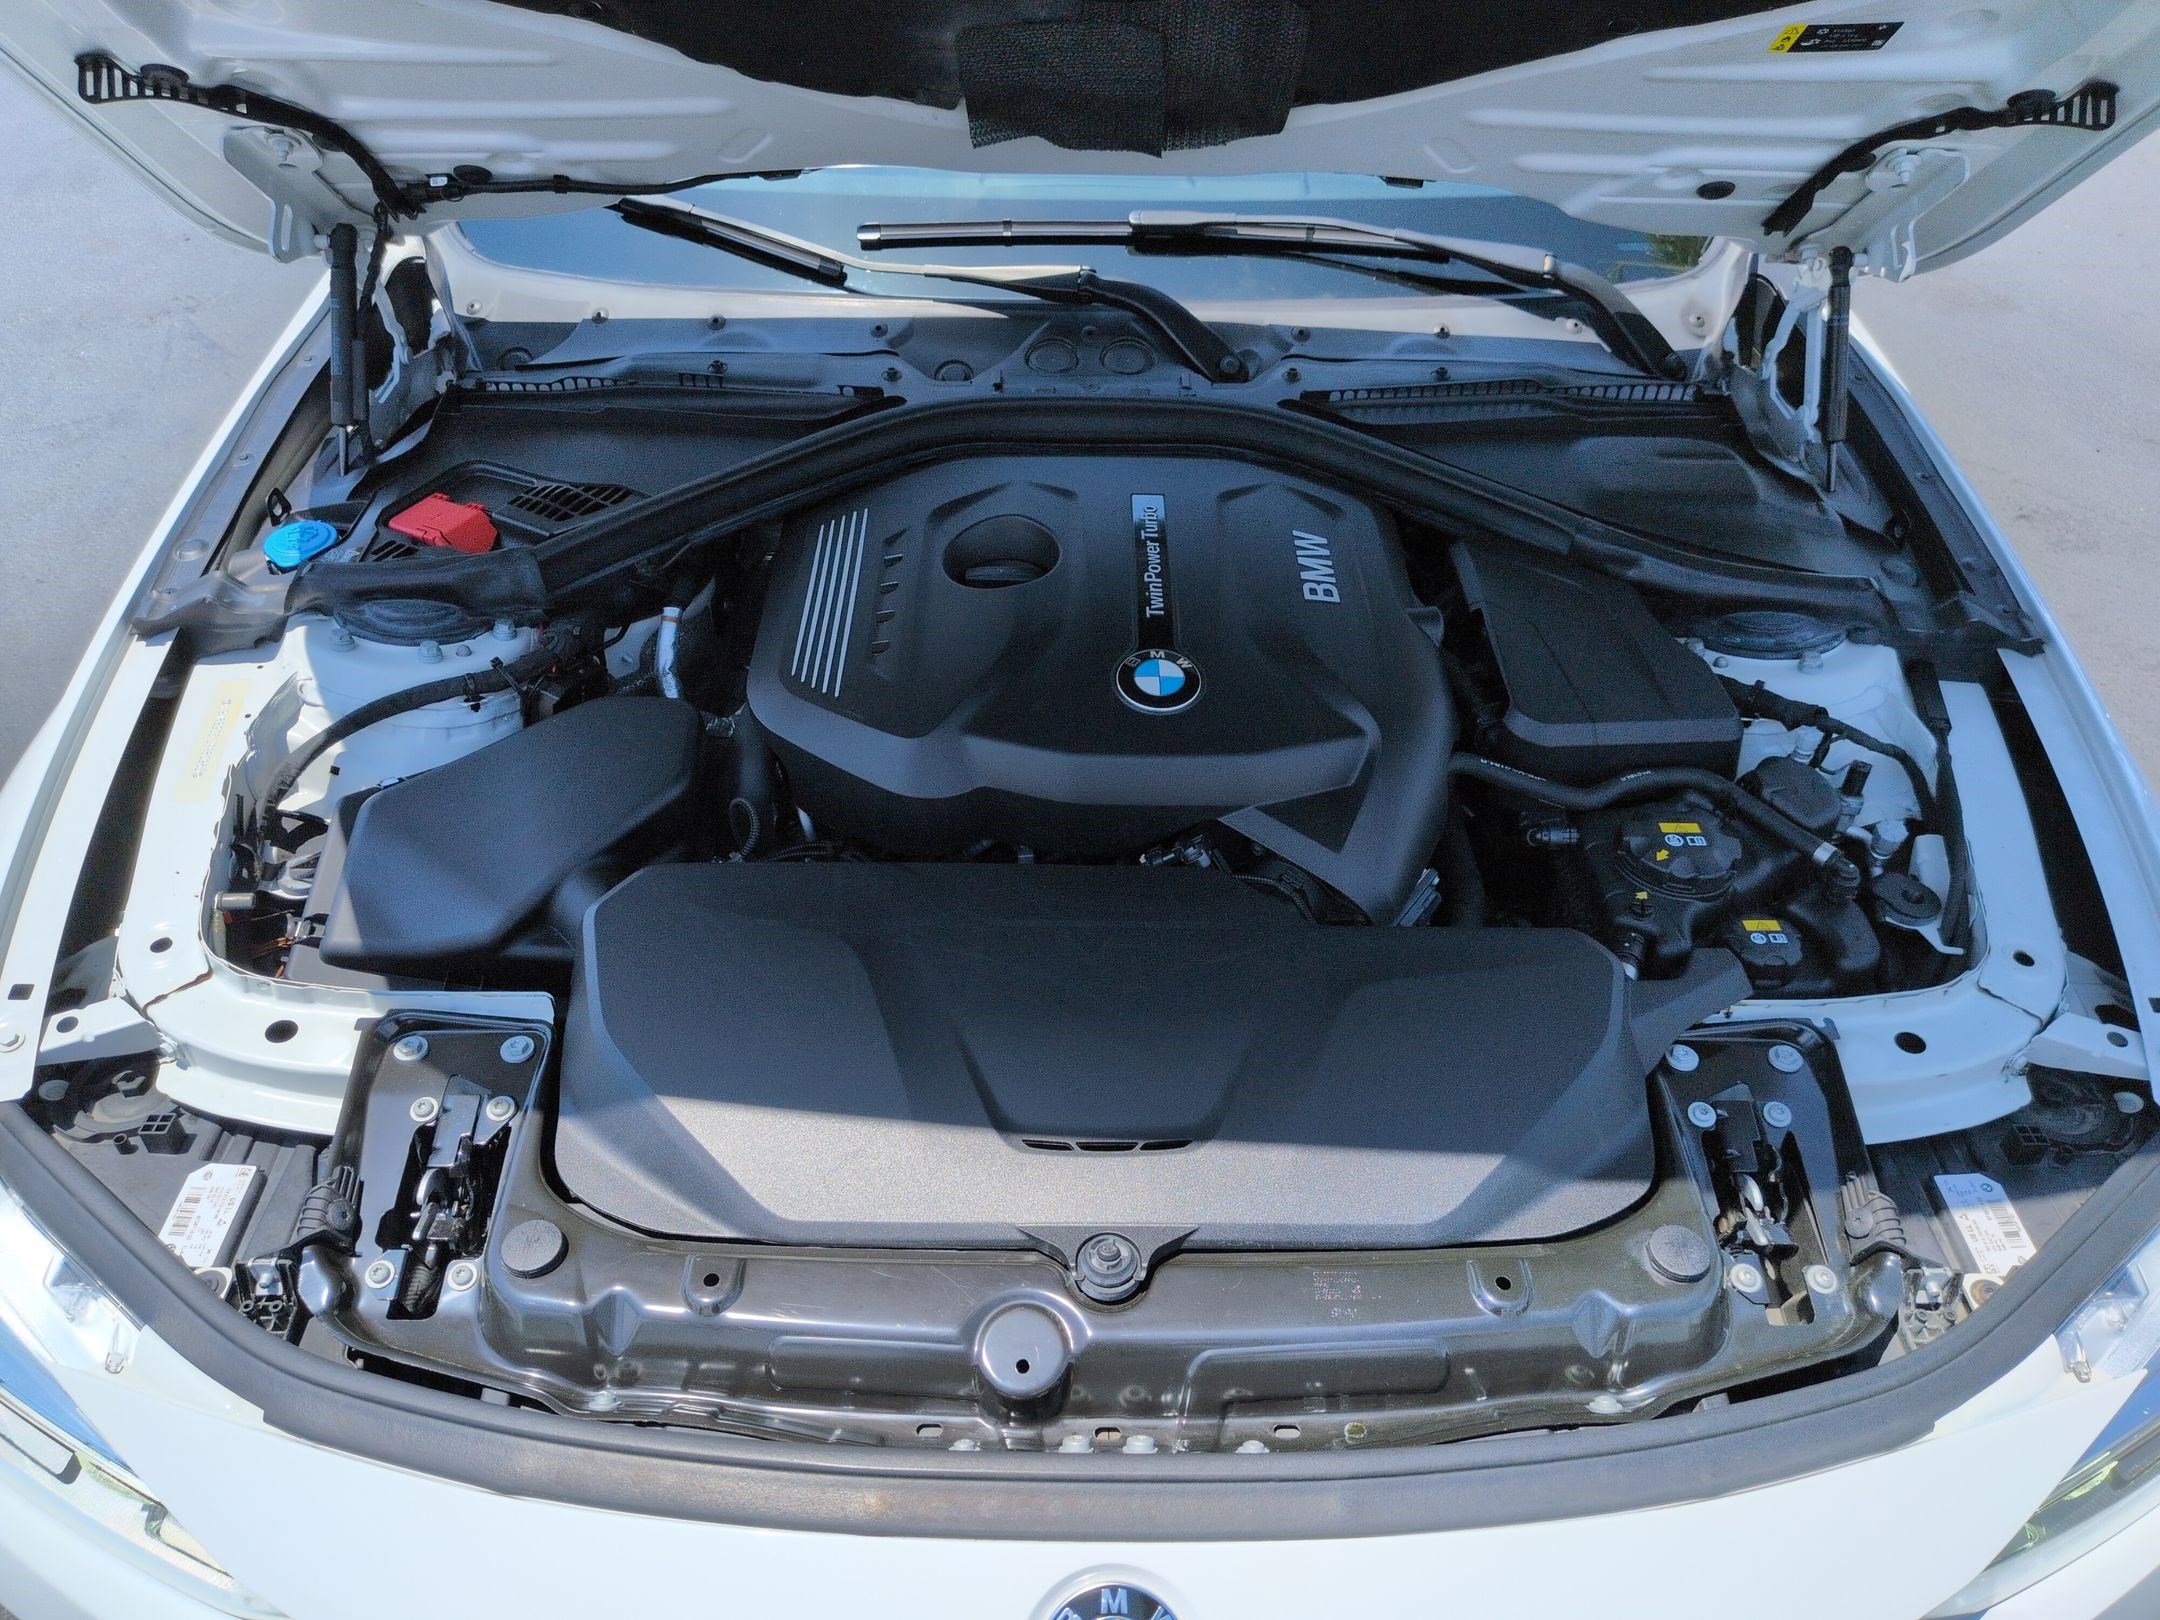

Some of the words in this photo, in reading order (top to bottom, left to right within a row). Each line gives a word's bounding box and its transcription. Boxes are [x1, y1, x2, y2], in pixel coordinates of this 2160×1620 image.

[1140, 504, 1159, 539] Turbo
[1143, 540, 1165, 618] TwinPower
[1292, 529, 1341, 604] BMW
[1125, 650, 1193, 669] BMW
